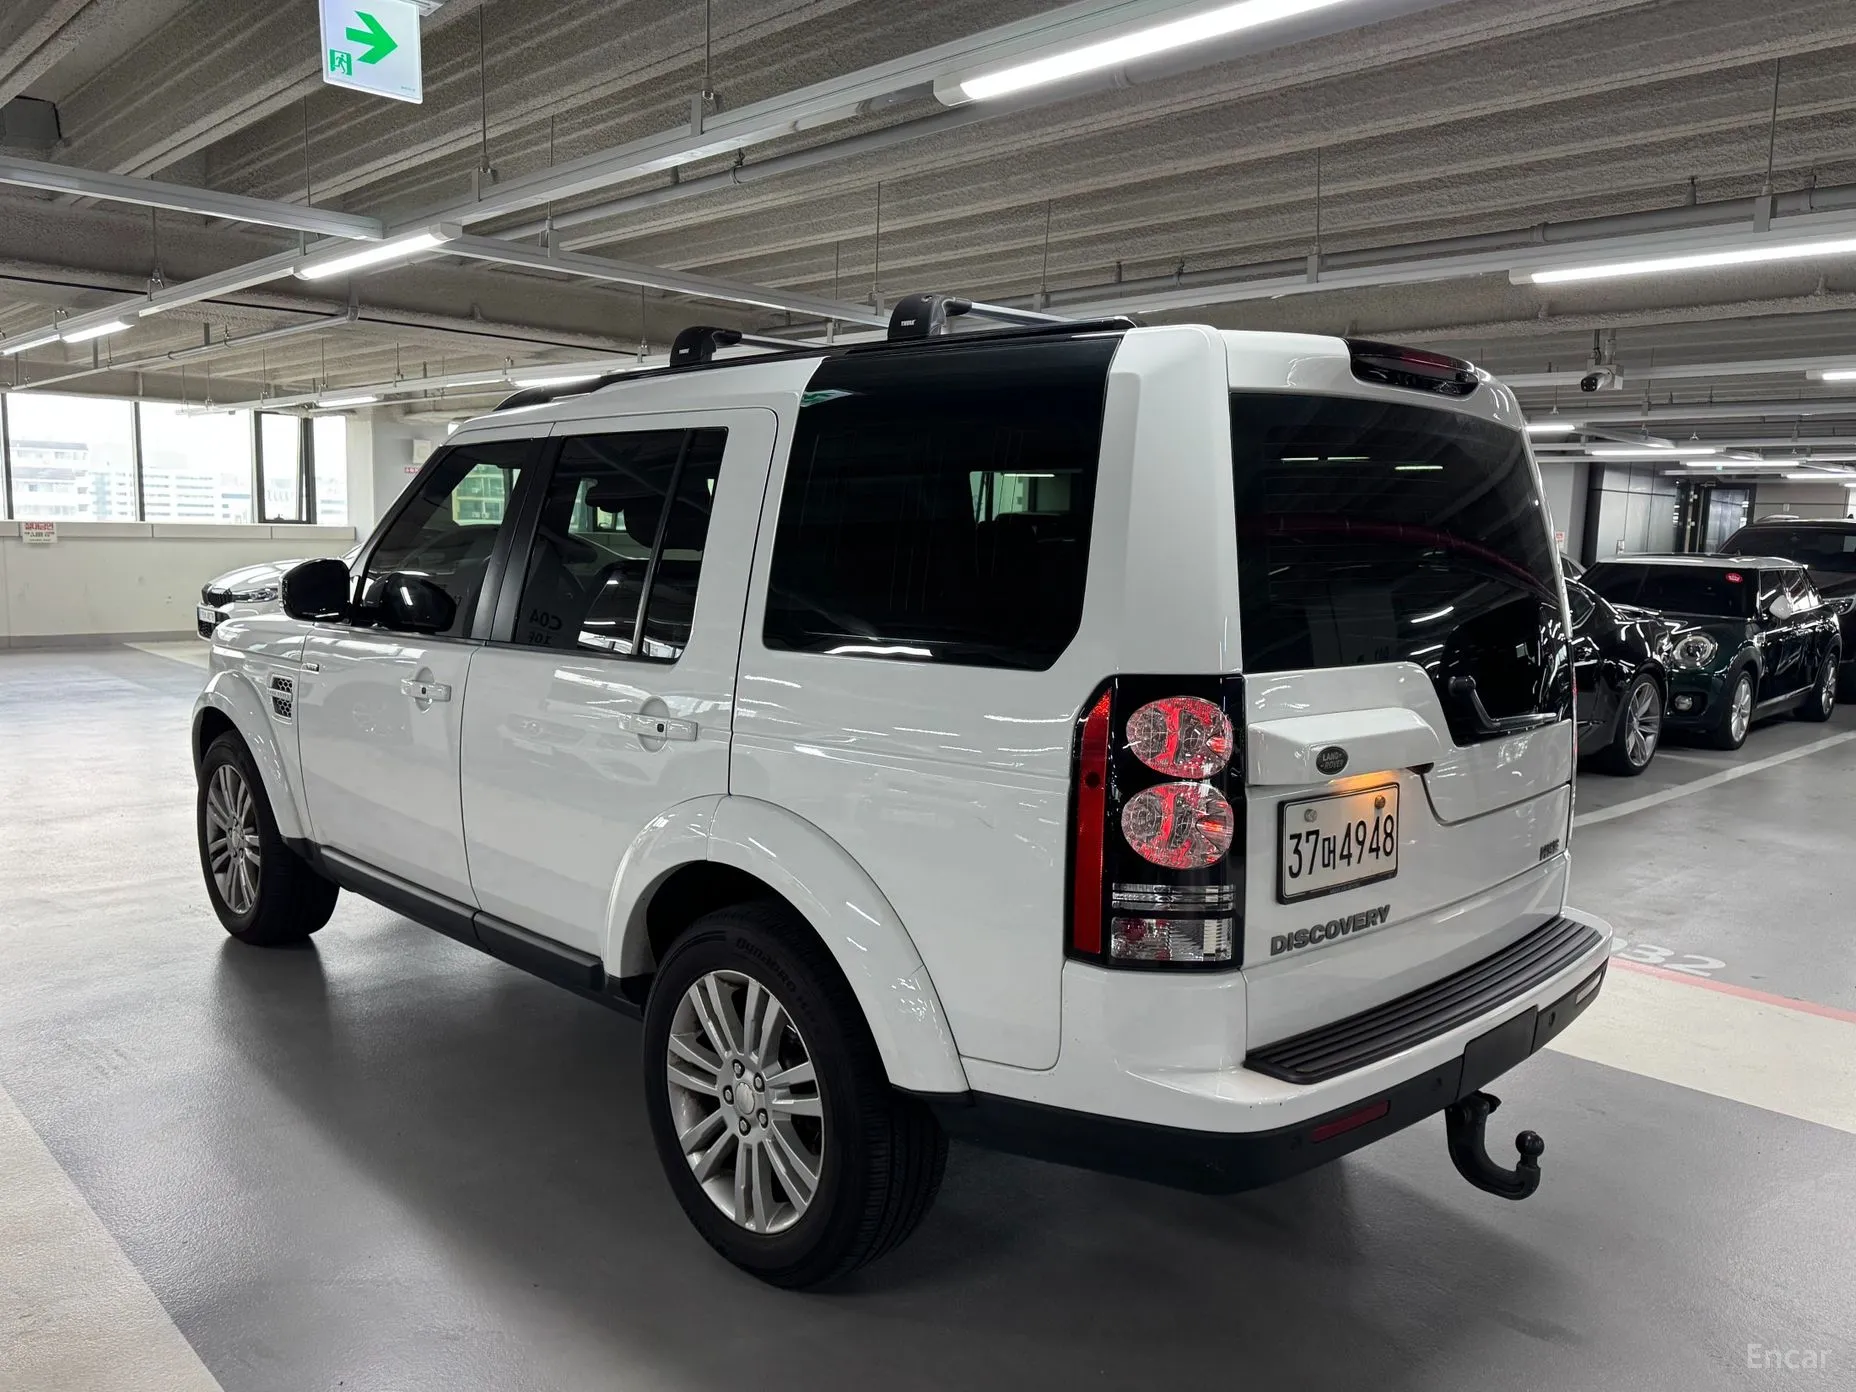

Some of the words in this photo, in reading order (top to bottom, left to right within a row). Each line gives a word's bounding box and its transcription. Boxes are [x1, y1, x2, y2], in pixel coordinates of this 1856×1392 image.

[1322, 752, 1339, 761] LAND
[1288, 814, 1395, 879] 37머4948
[1270, 904, 1391, 956] DISCOVERY
